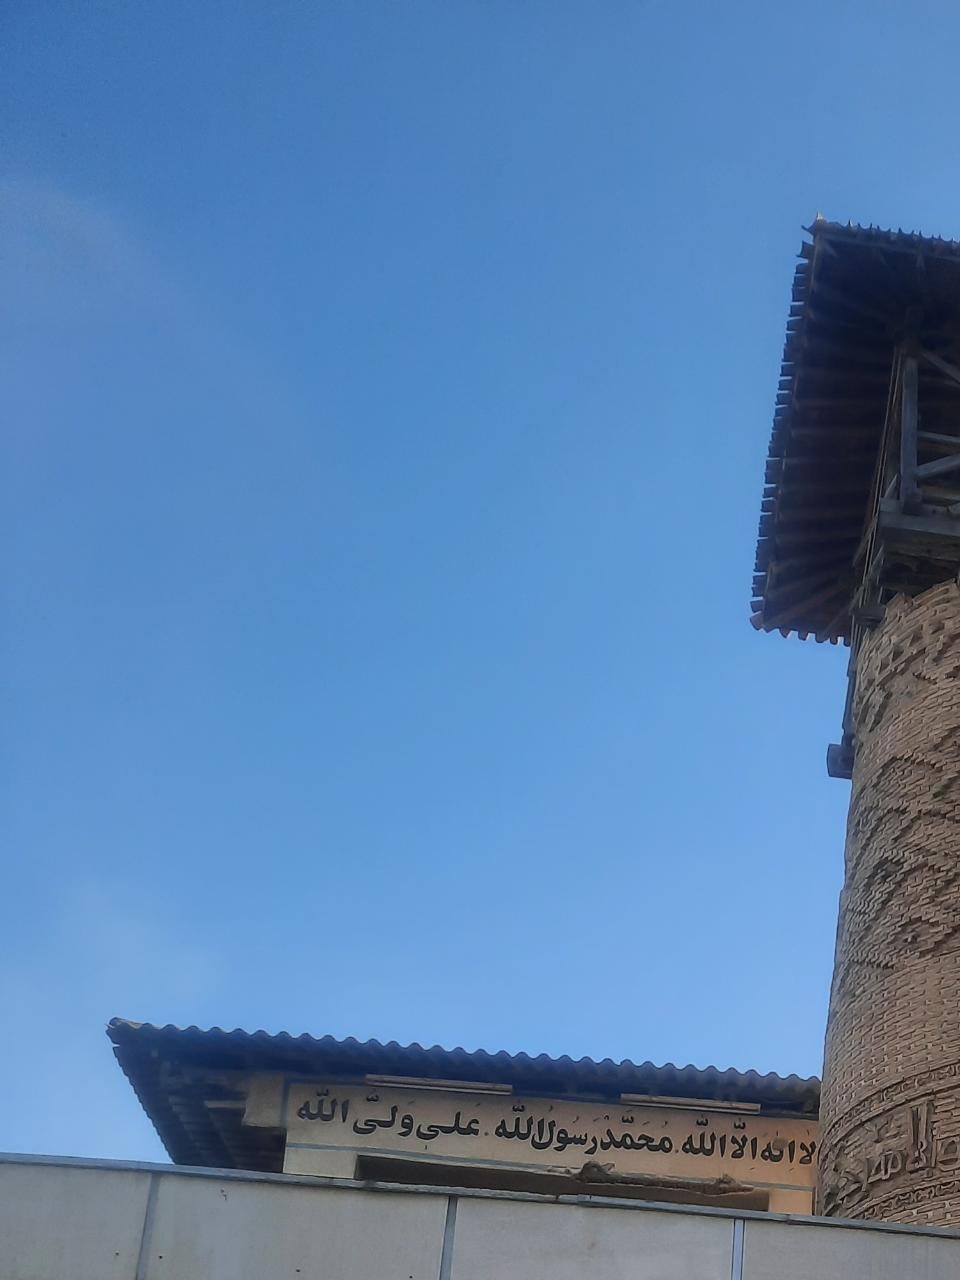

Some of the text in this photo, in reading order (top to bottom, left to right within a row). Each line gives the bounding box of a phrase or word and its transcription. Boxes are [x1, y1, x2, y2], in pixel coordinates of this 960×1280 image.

[296, 1088, 350, 1124] الله
[494, 1104, 546, 1142] الله
[530, 1115, 599, 1155] رسول
[681, 1116, 728, 1158] الله
